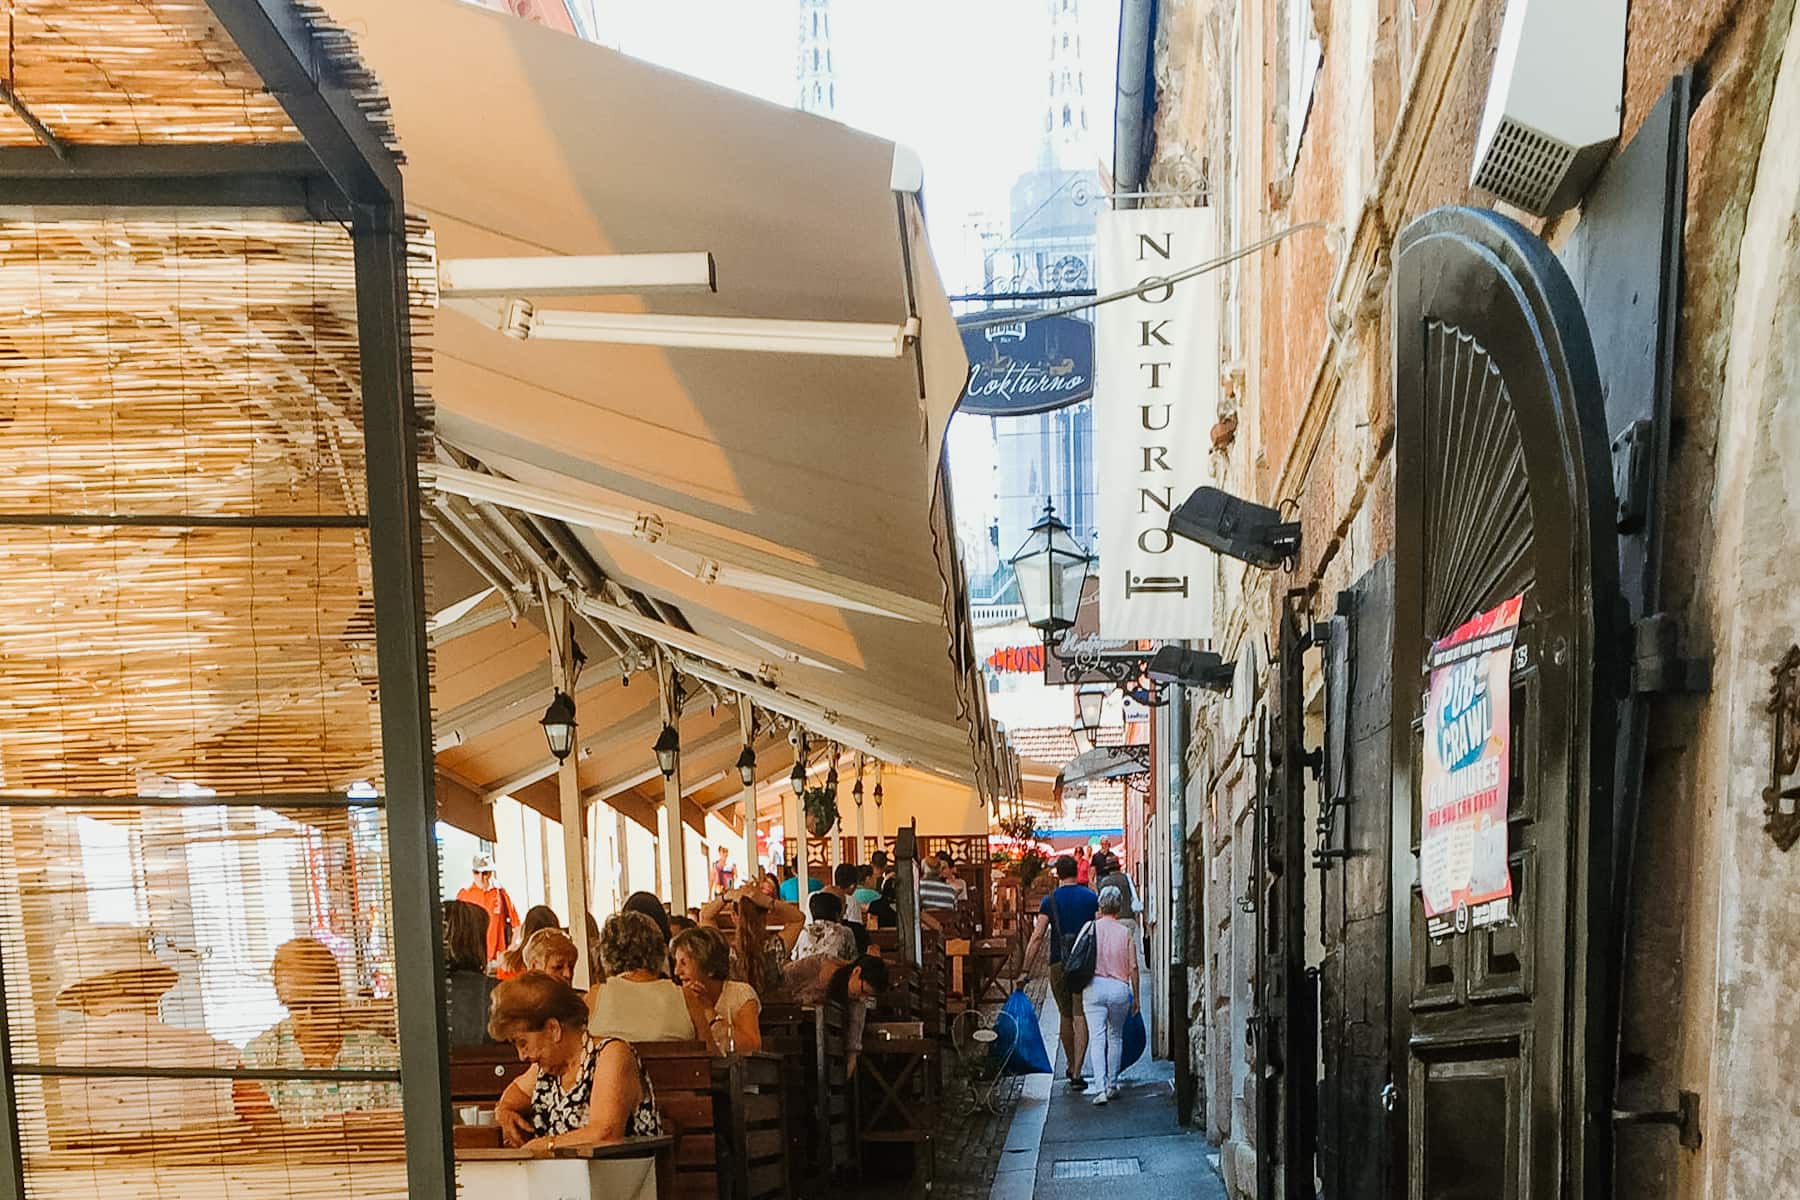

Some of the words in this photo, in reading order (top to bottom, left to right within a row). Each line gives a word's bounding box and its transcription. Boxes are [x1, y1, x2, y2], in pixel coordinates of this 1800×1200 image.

[1136, 231, 1174, 555] NOKTURNO
[1440, 657, 1476, 728] PUB
[1442, 696, 1492, 770] CRAWL
[1449, 755, 1500, 803] MINUTES
